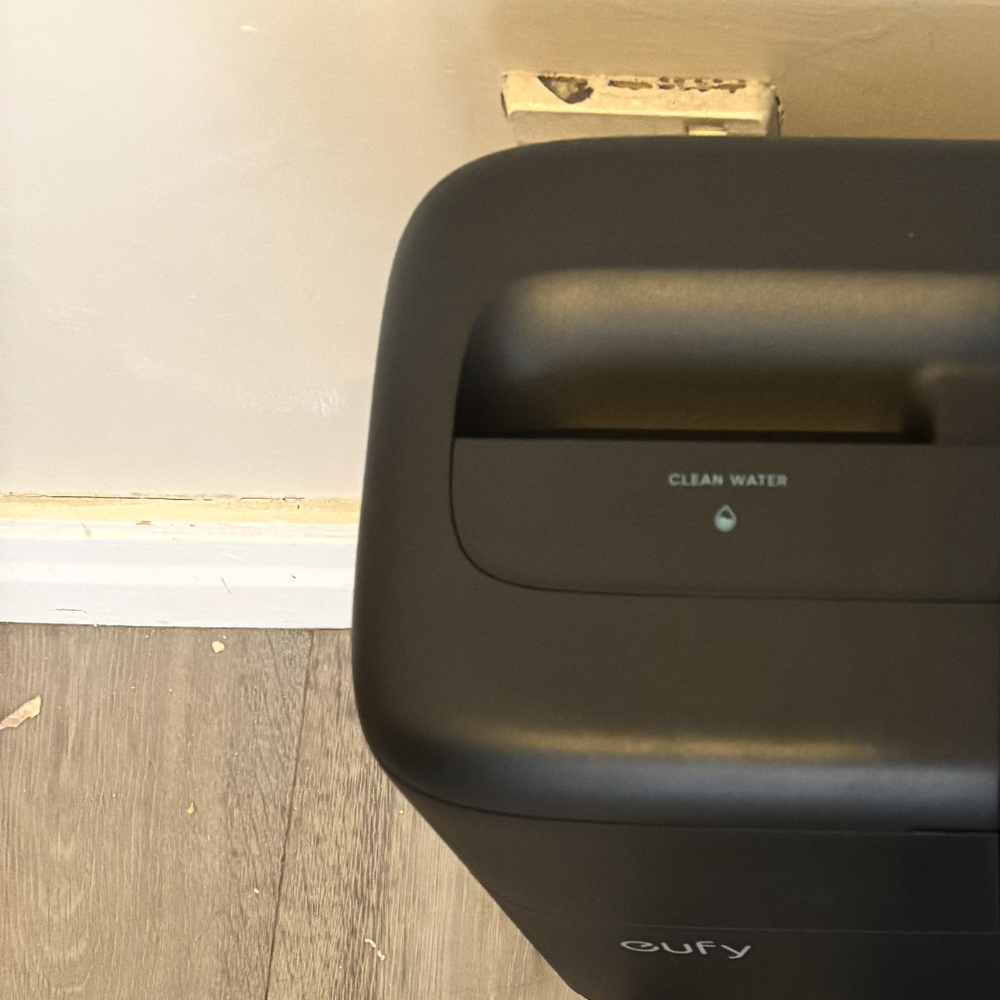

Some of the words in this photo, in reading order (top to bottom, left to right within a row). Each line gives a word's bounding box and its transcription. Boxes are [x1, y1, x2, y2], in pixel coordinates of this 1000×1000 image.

[668, 473, 724, 487] CLEAN
[729, 473, 788, 487] WATER
[619, 939, 752, 960] eufy
